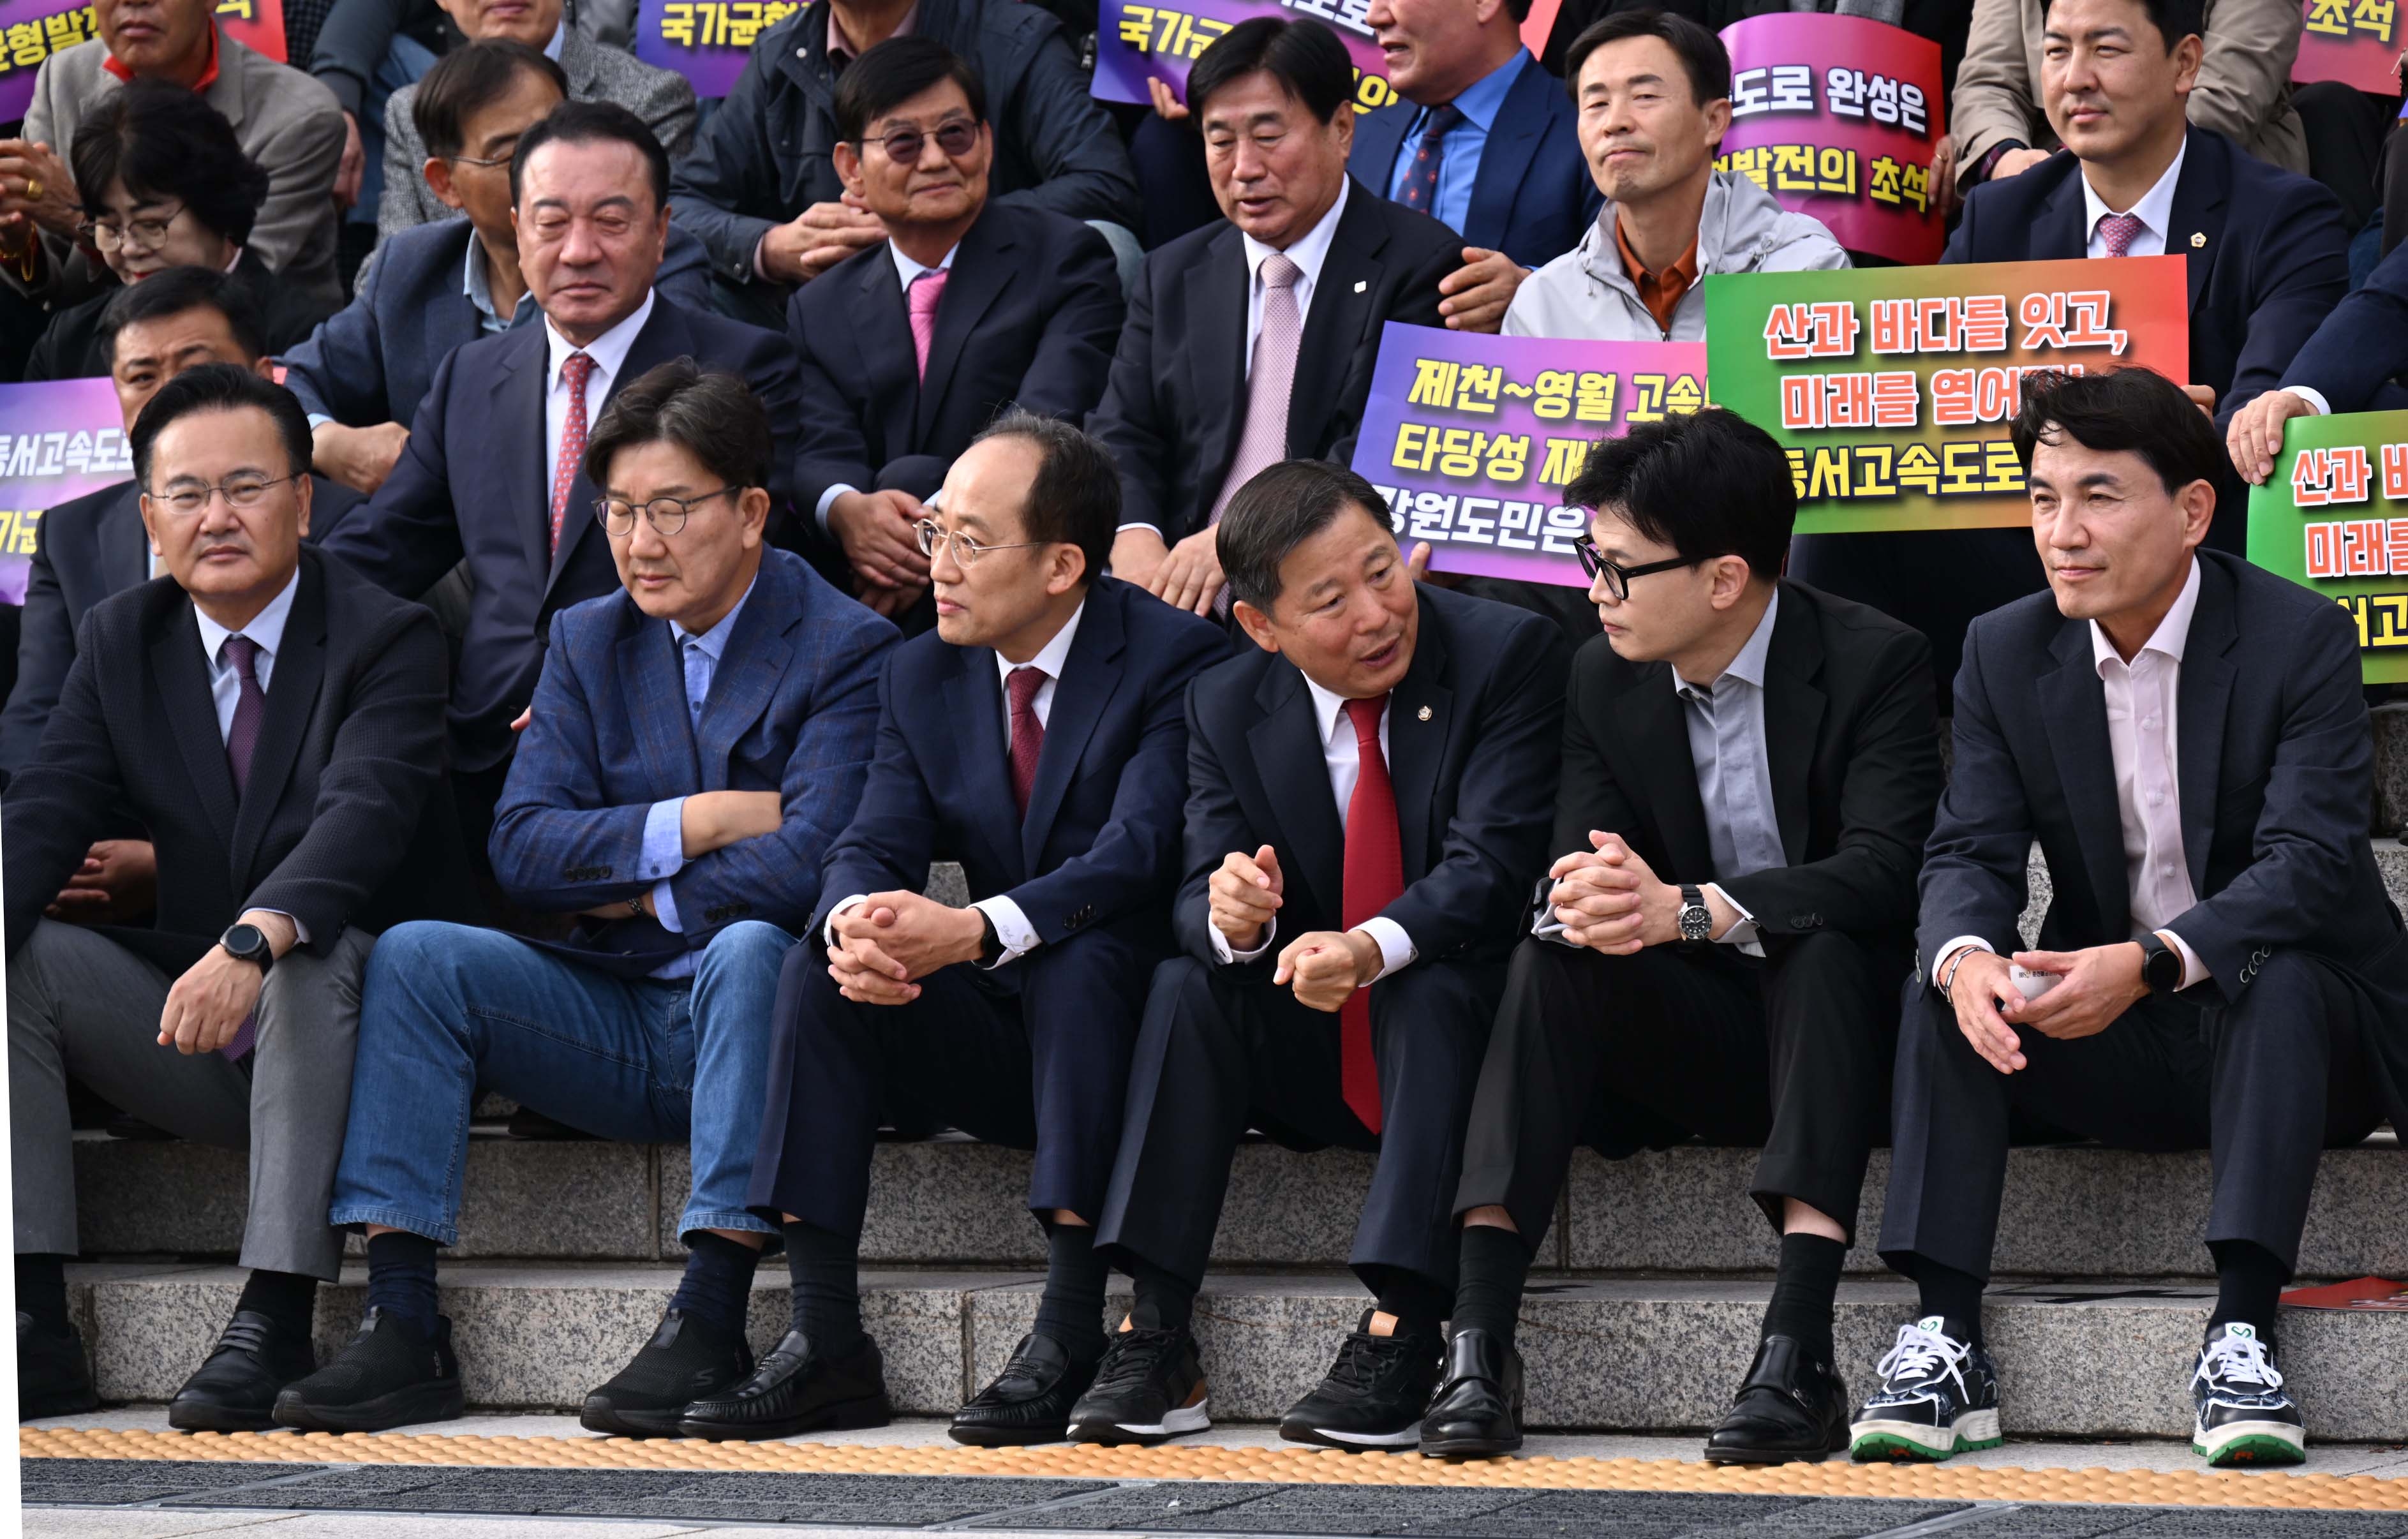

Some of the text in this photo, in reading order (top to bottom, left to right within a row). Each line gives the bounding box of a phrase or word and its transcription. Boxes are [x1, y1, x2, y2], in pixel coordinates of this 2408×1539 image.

[0, 6, 101, 71] 형발
[661, 1, 810, 46] 국가균
[1728, 65, 1926, 133] 도로 완성은
[1869, 156, 1930, 213] 초석
[1763, 290, 2127, 360] 산과 바다를 잇고,
[1407, 359, 1710, 422] 제천~영월 고속
[1781, 364, 2084, 429] 미래를 열어
[1392, 422, 1603, 486] 타당성 재
[2291, 446, 2372, 506] 산과
[1372, 484, 1586, 554] 강원도민은
